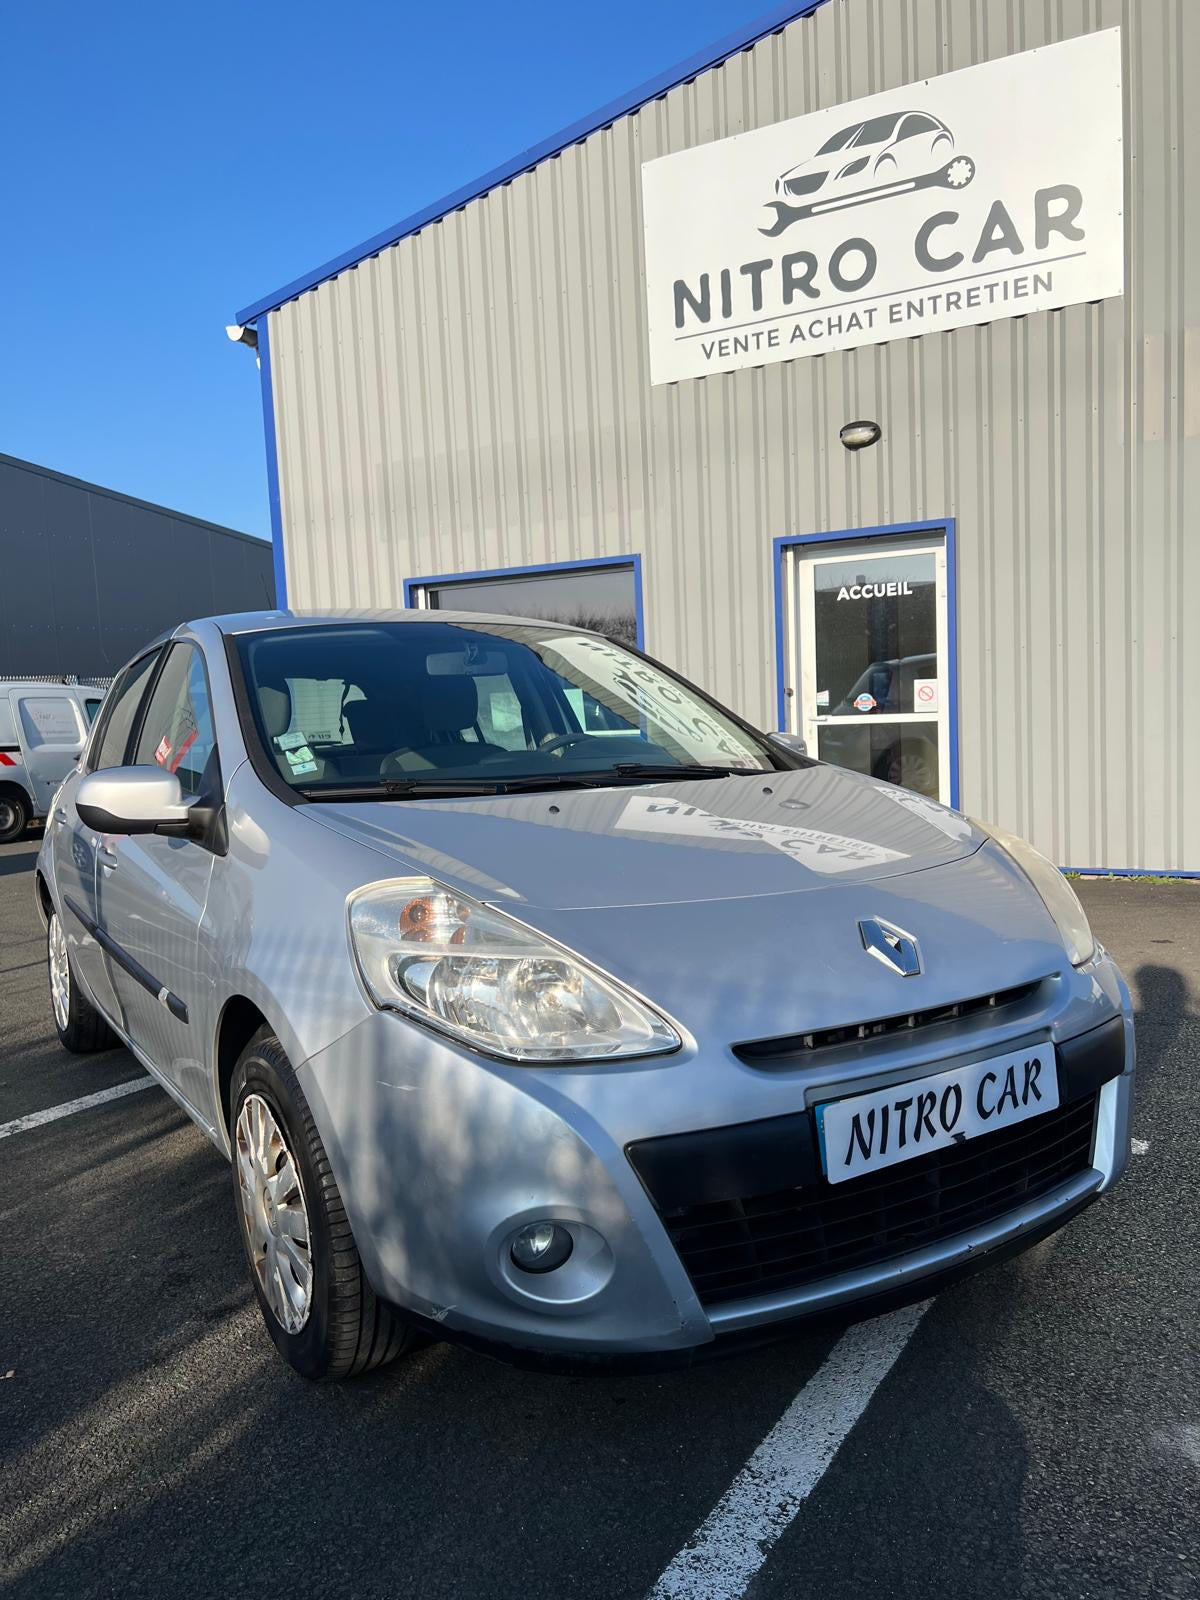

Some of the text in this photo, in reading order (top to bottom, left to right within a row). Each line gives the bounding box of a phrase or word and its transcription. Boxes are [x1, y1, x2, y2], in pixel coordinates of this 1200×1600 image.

[673, 184, 1085, 329] NITRO CAR
[700, 271, 1053, 360] VENTE ACHAT ENTRETIEN
[837, 581, 913, 601] ACCUEIL
[844, 1058, 1042, 1166] NITRO CAR
